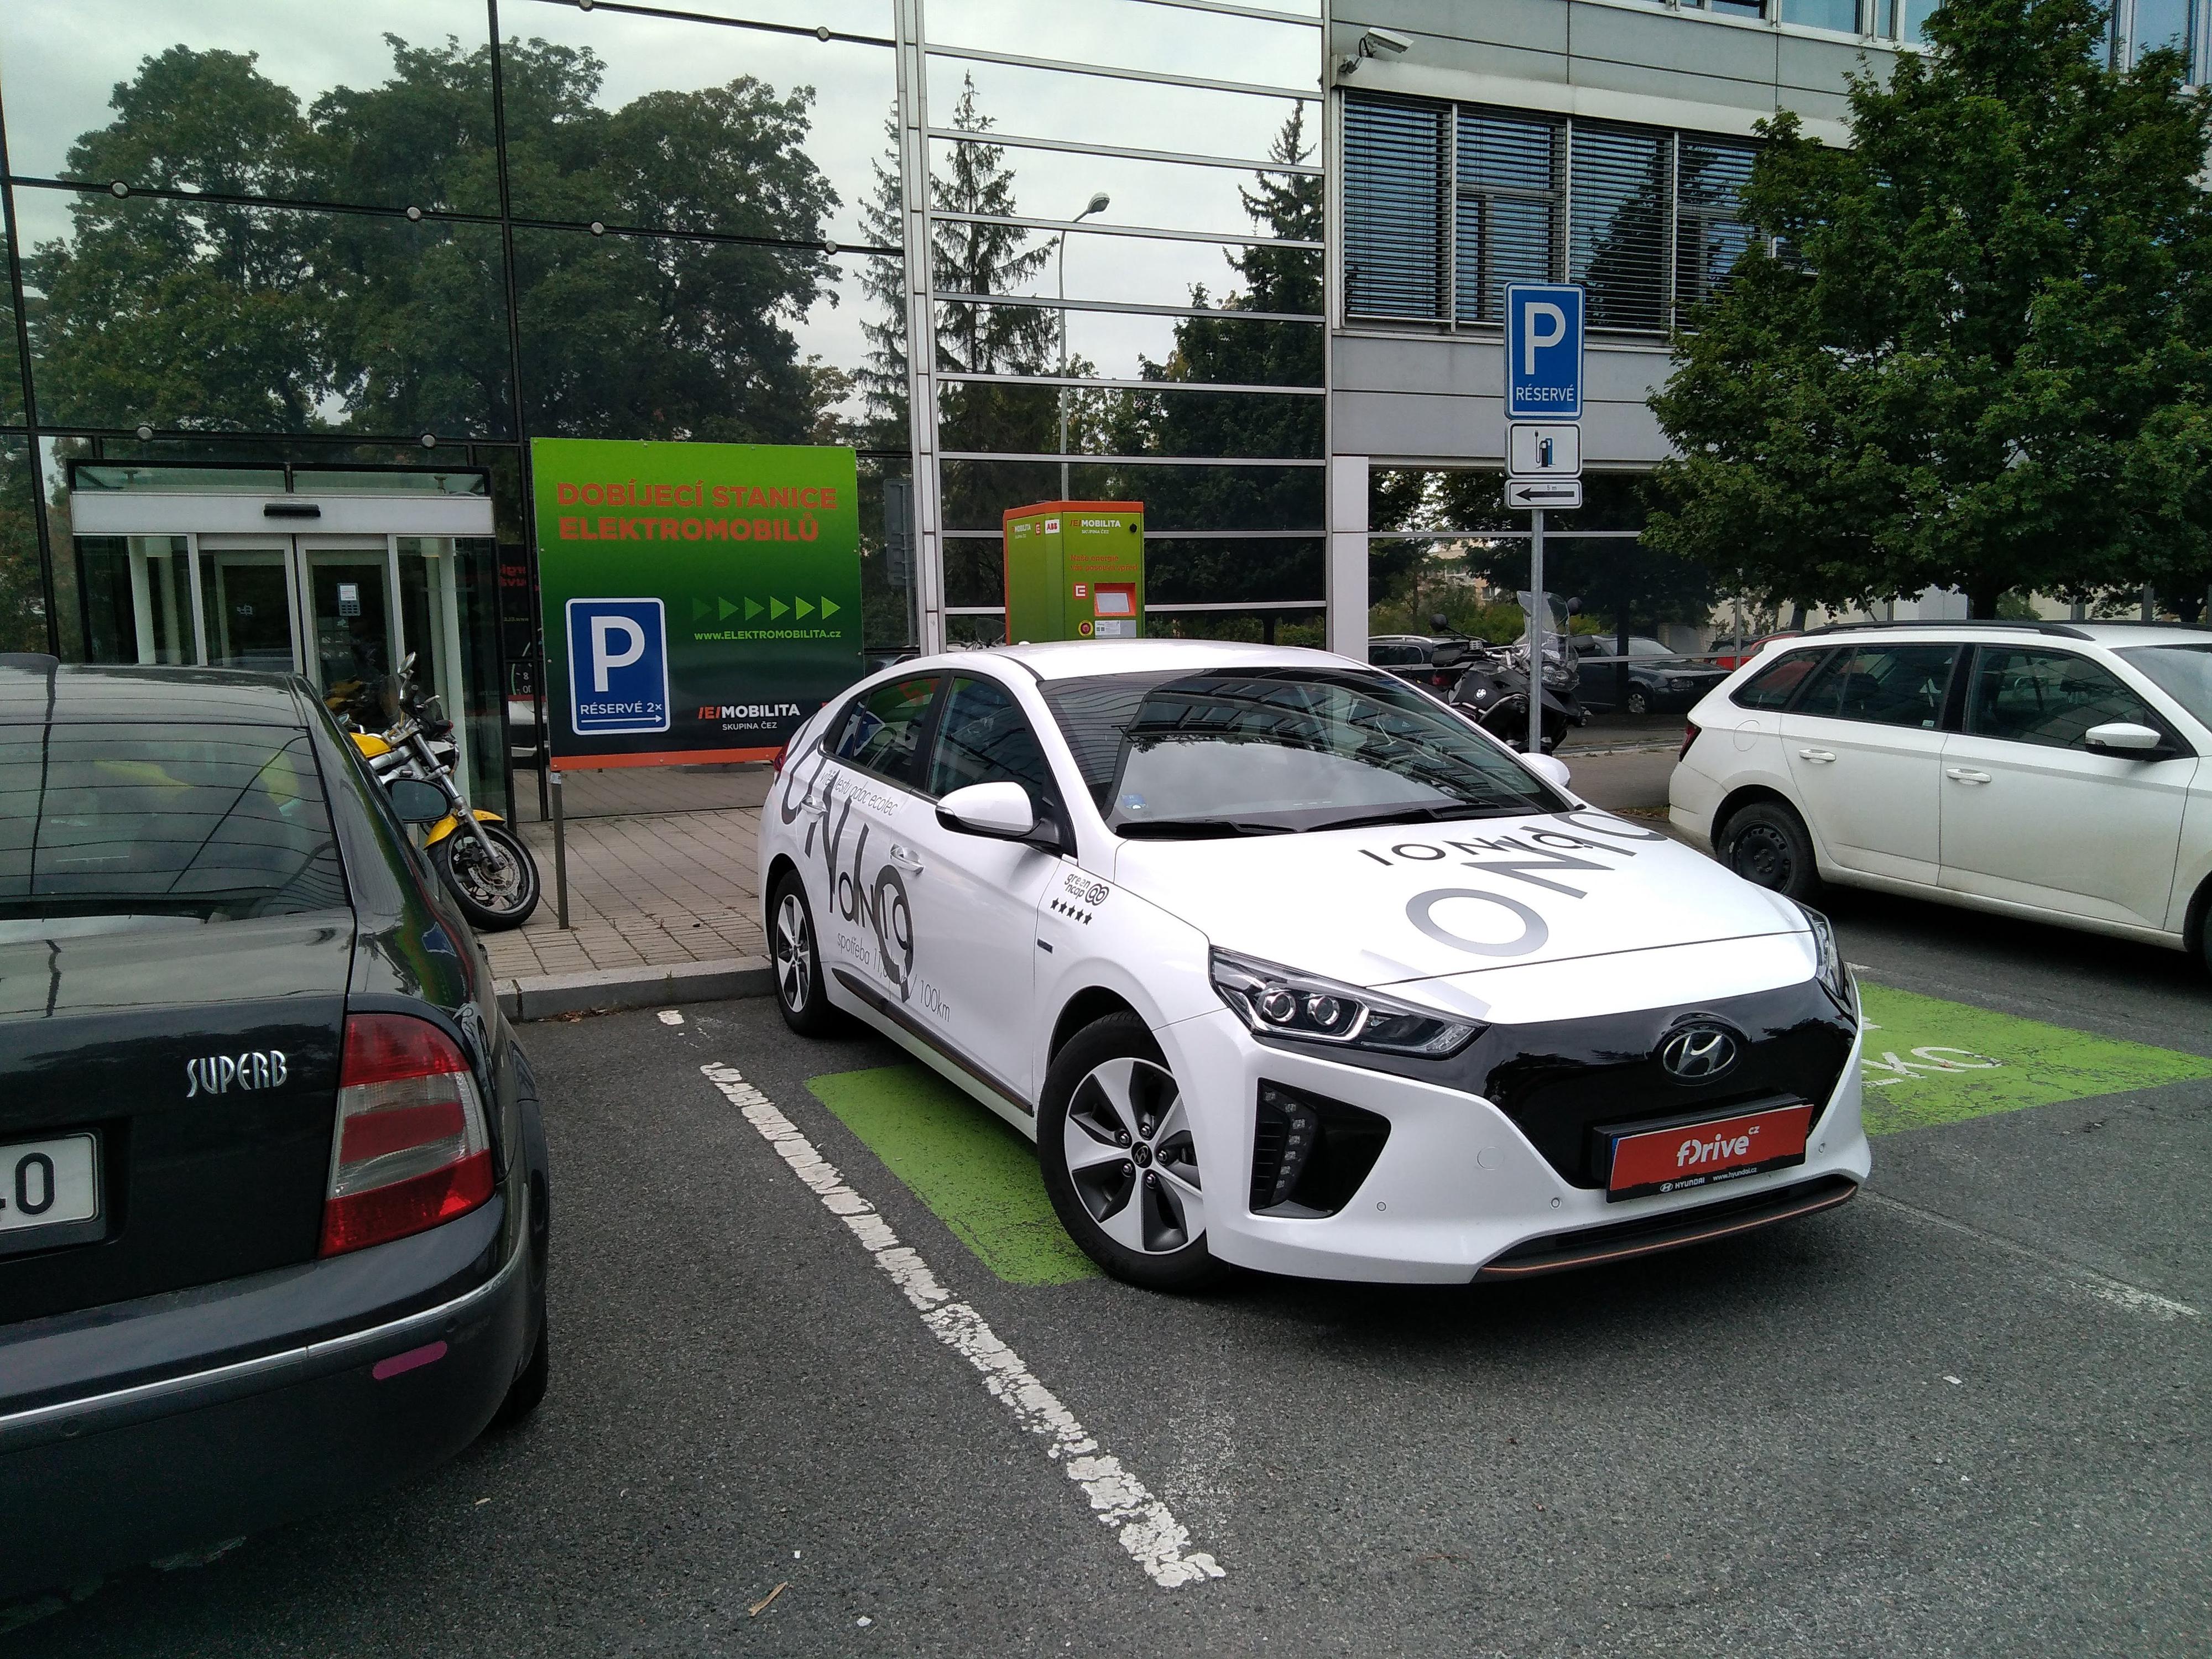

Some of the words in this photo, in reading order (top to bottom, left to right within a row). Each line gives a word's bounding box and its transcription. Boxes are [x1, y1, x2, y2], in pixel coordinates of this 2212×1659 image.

[1525, 302, 1566, 374] P
[1516, 384, 1574, 402] RÉSERVÉ
[557, 478, 703, 508] DOBÍJECÍ
[712, 486, 837, 509] STANICE
[559, 512, 818, 541] ELEKTROMOBILŮ
[1047, 522, 1057, 530] ABB
[694, 629, 841, 640] www.ELEKTROMOBILITA.cz
[591, 616, 645, 692] P
[580, 700, 643, 715] RÉSERVÉ
[761, 721, 778, 729] ČEZ
[1358, 833, 1593, 866] IONIQ
[1065, 874, 1091, 889] green
[1065, 884, 1085, 899] ncap
[837, 932, 870, 965] spotřeba
[921, 979, 950, 1022] 100km
[186, 1050, 287, 1098] SUPERB
[0, 1152, 56, 1216] 0
[1675, 1177, 1705, 1189] HYUNDAI
[1713, 1167, 1757, 1181] www.hyundai.cz
